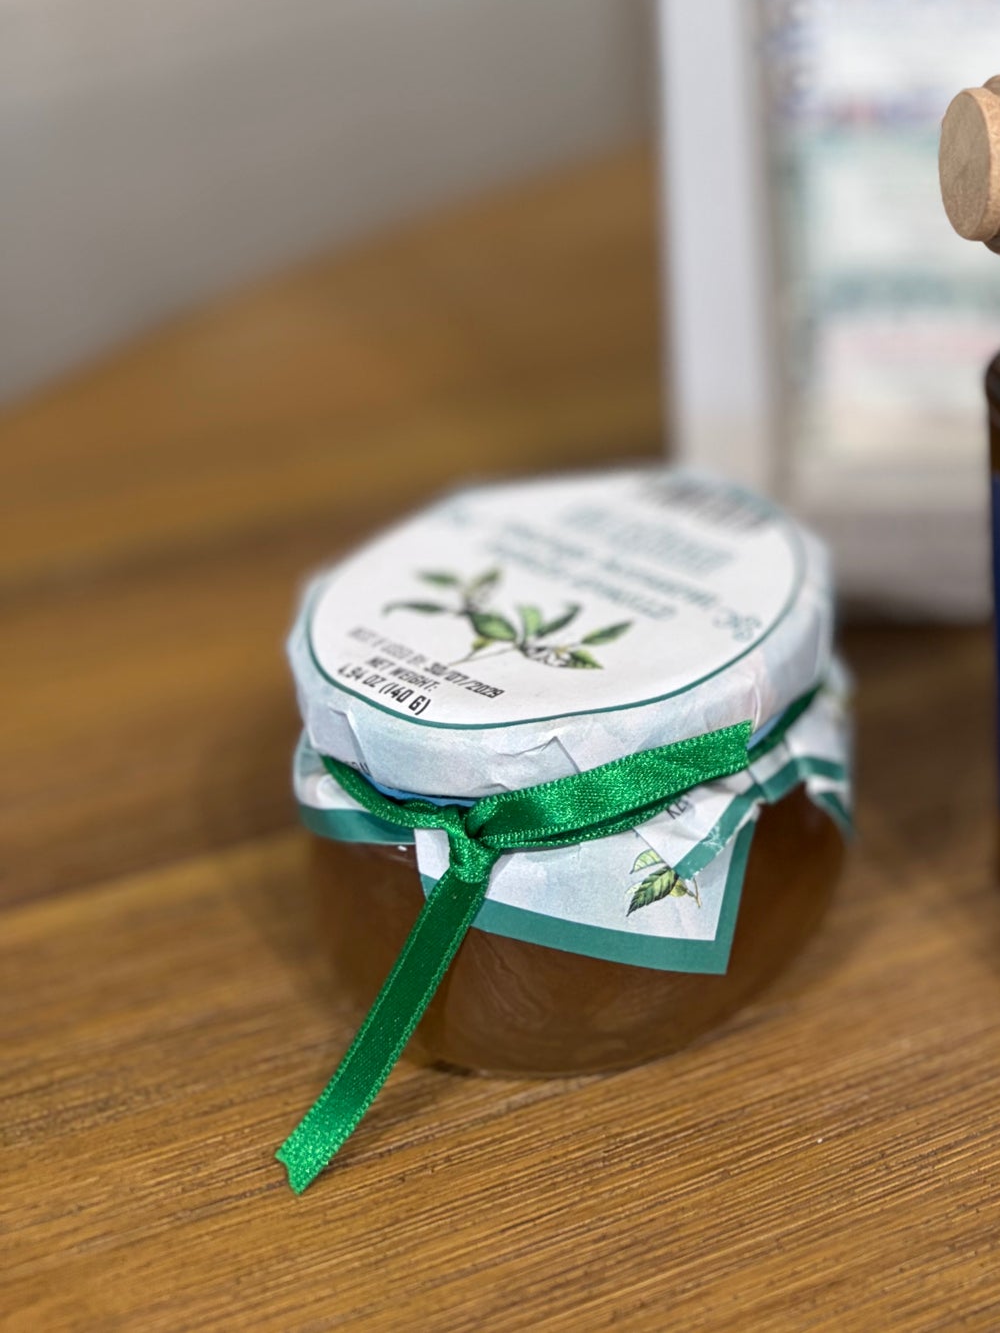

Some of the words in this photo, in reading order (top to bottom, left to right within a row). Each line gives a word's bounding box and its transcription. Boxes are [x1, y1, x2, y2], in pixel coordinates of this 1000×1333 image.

[362, 674, 387, 688] OZ
[378, 680, 414, 703] (140
[408, 696, 431, 716] G)
[389, 666, 440, 692] WEIGHT:
